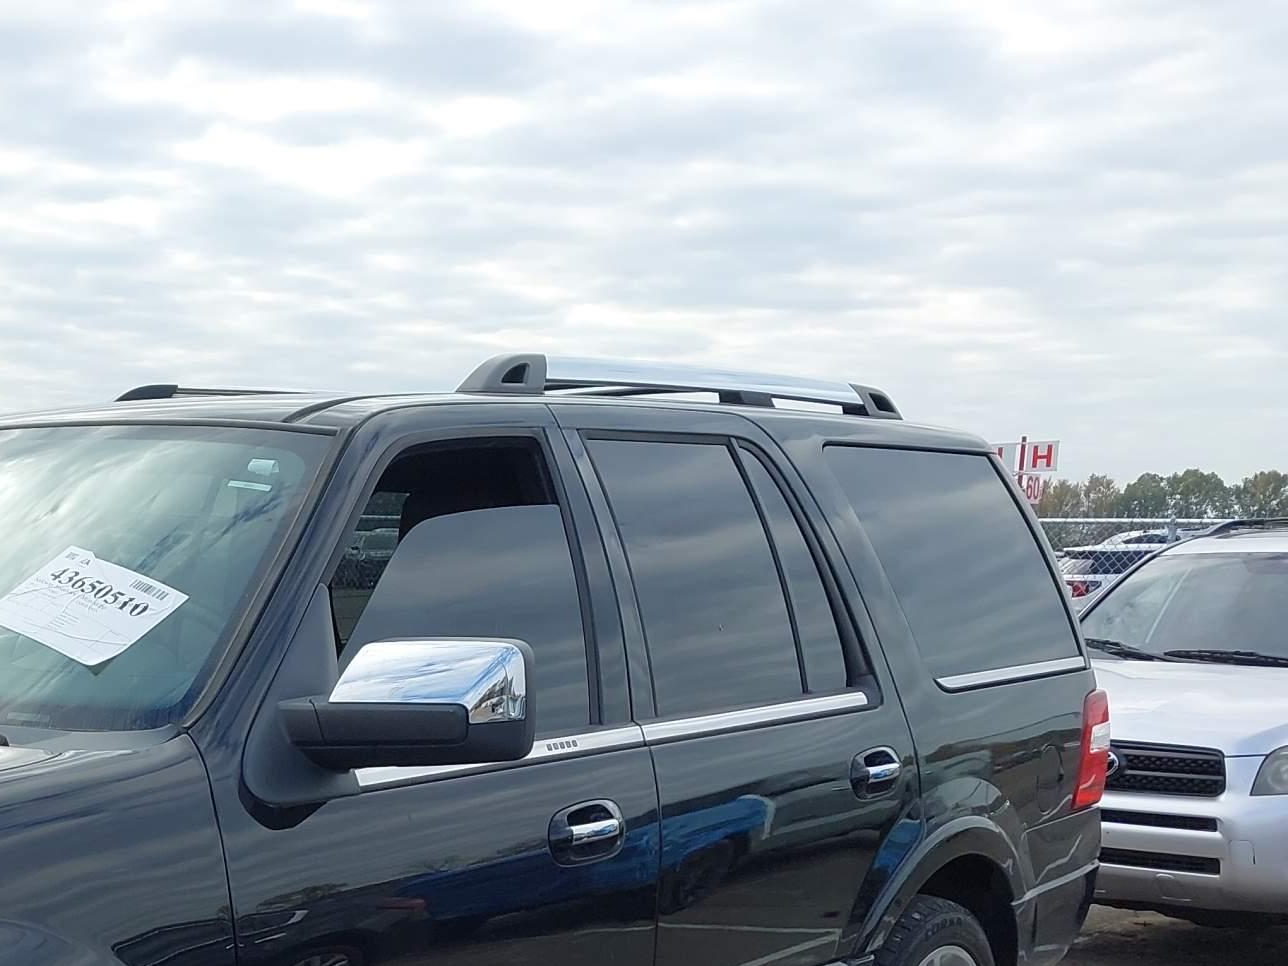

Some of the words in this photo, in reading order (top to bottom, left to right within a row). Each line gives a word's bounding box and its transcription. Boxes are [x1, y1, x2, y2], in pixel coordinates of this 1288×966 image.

[1031, 444, 1053, 469] H
[1026, 475, 1040, 500] 60
[50, 567, 150, 617] 43650510
